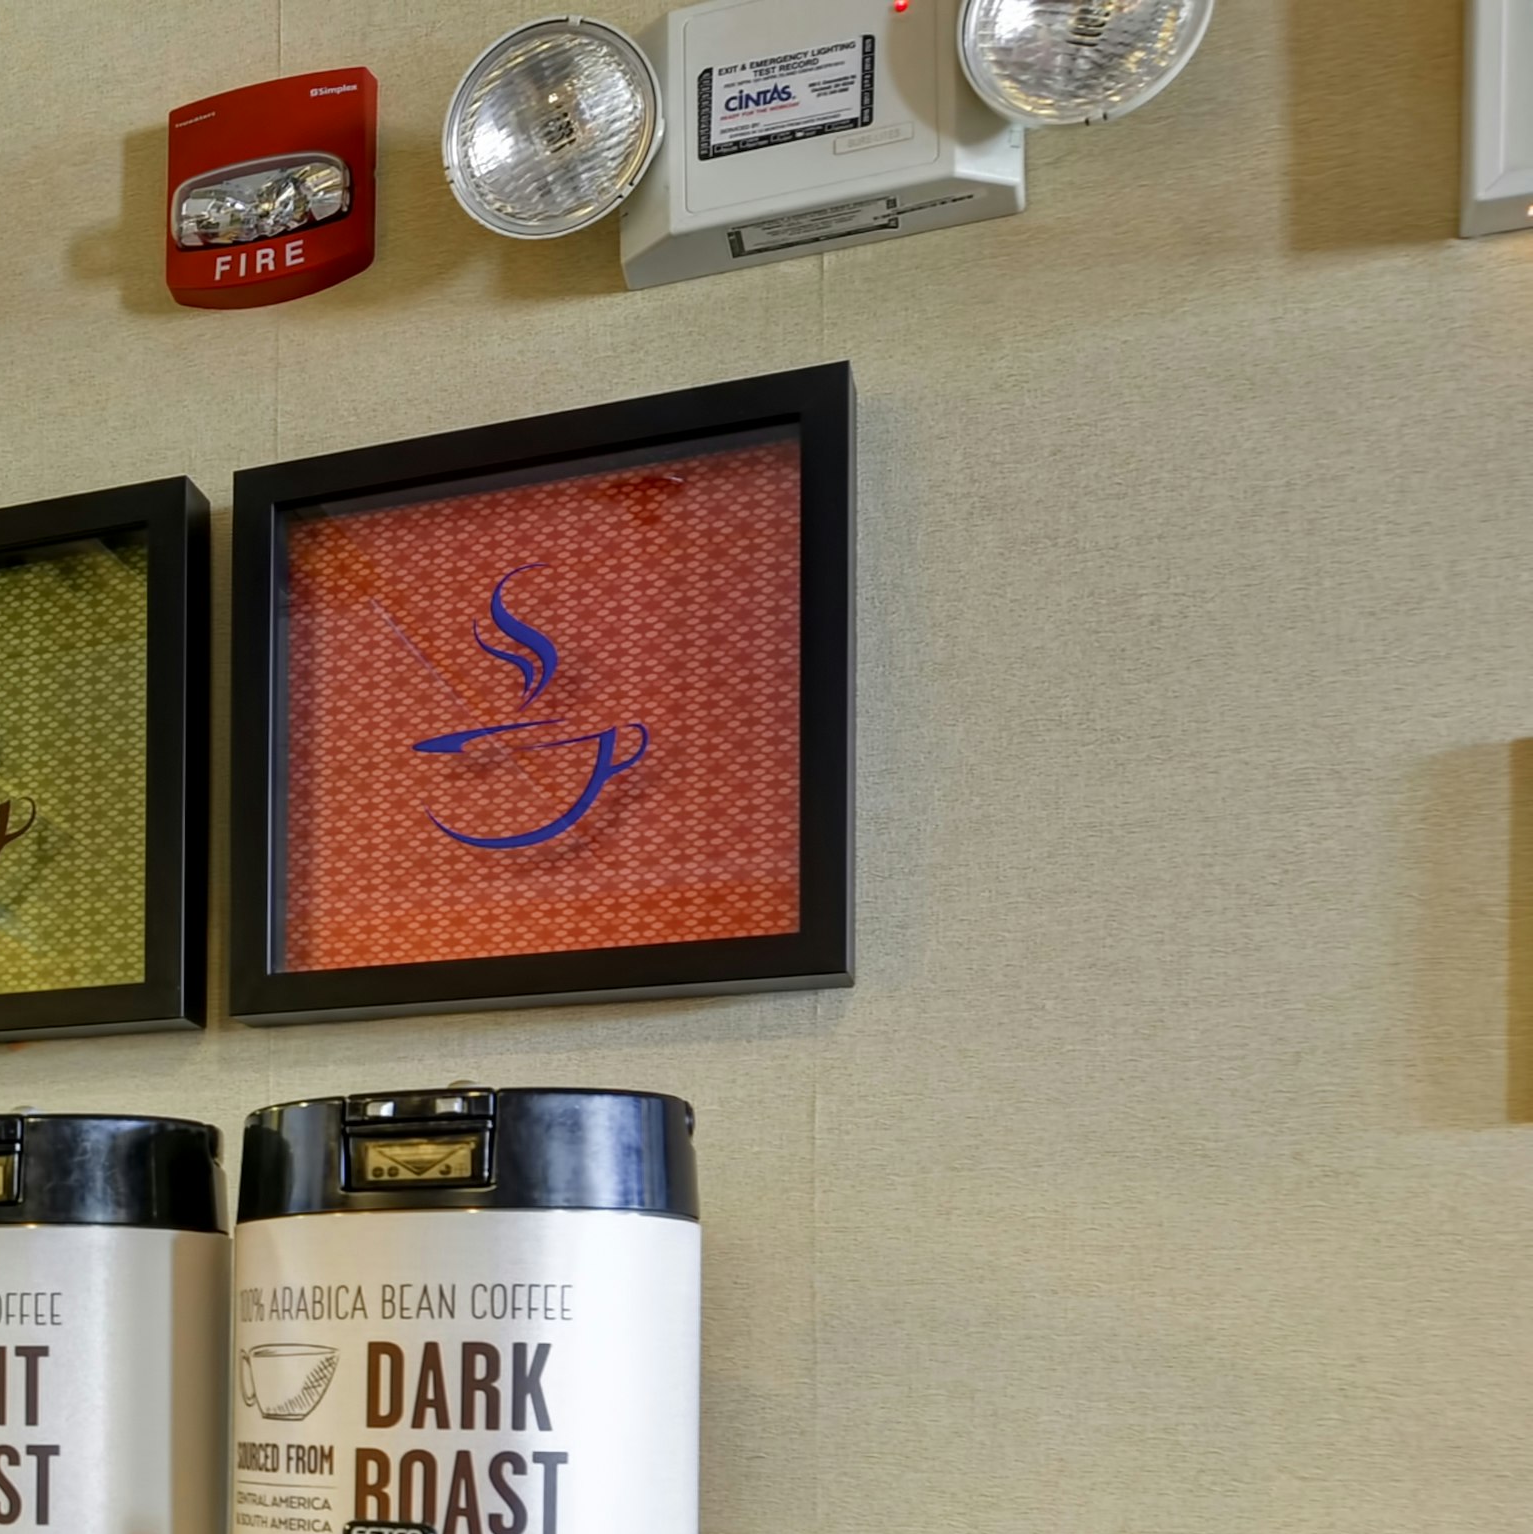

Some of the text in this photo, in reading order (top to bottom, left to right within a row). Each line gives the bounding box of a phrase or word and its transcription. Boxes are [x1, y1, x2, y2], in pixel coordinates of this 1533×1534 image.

[718, 65, 738, 76] EXIT
[740, 63, 747, 72] &
[749, 51, 809, 69] EMERGENCY
[811, 41, 856, 57] LIGHTING
[753, 66, 776, 77] TEST
[779, 58, 819, 72] RECORD
[214, 239, 305, 281] FIRE
[269, 1284, 368, 1323] ARABICA
[381, 1283, 457, 1320] BEAN
[470, 1283, 575, 1321] COFFEE
[365, 1340, 554, 1432] DARK
[237, 1441, 334, 1476] SOURCED FROM
[270, 1494, 333, 1511] AMERICA
[269, 1515, 334, 1534] AMERICA
